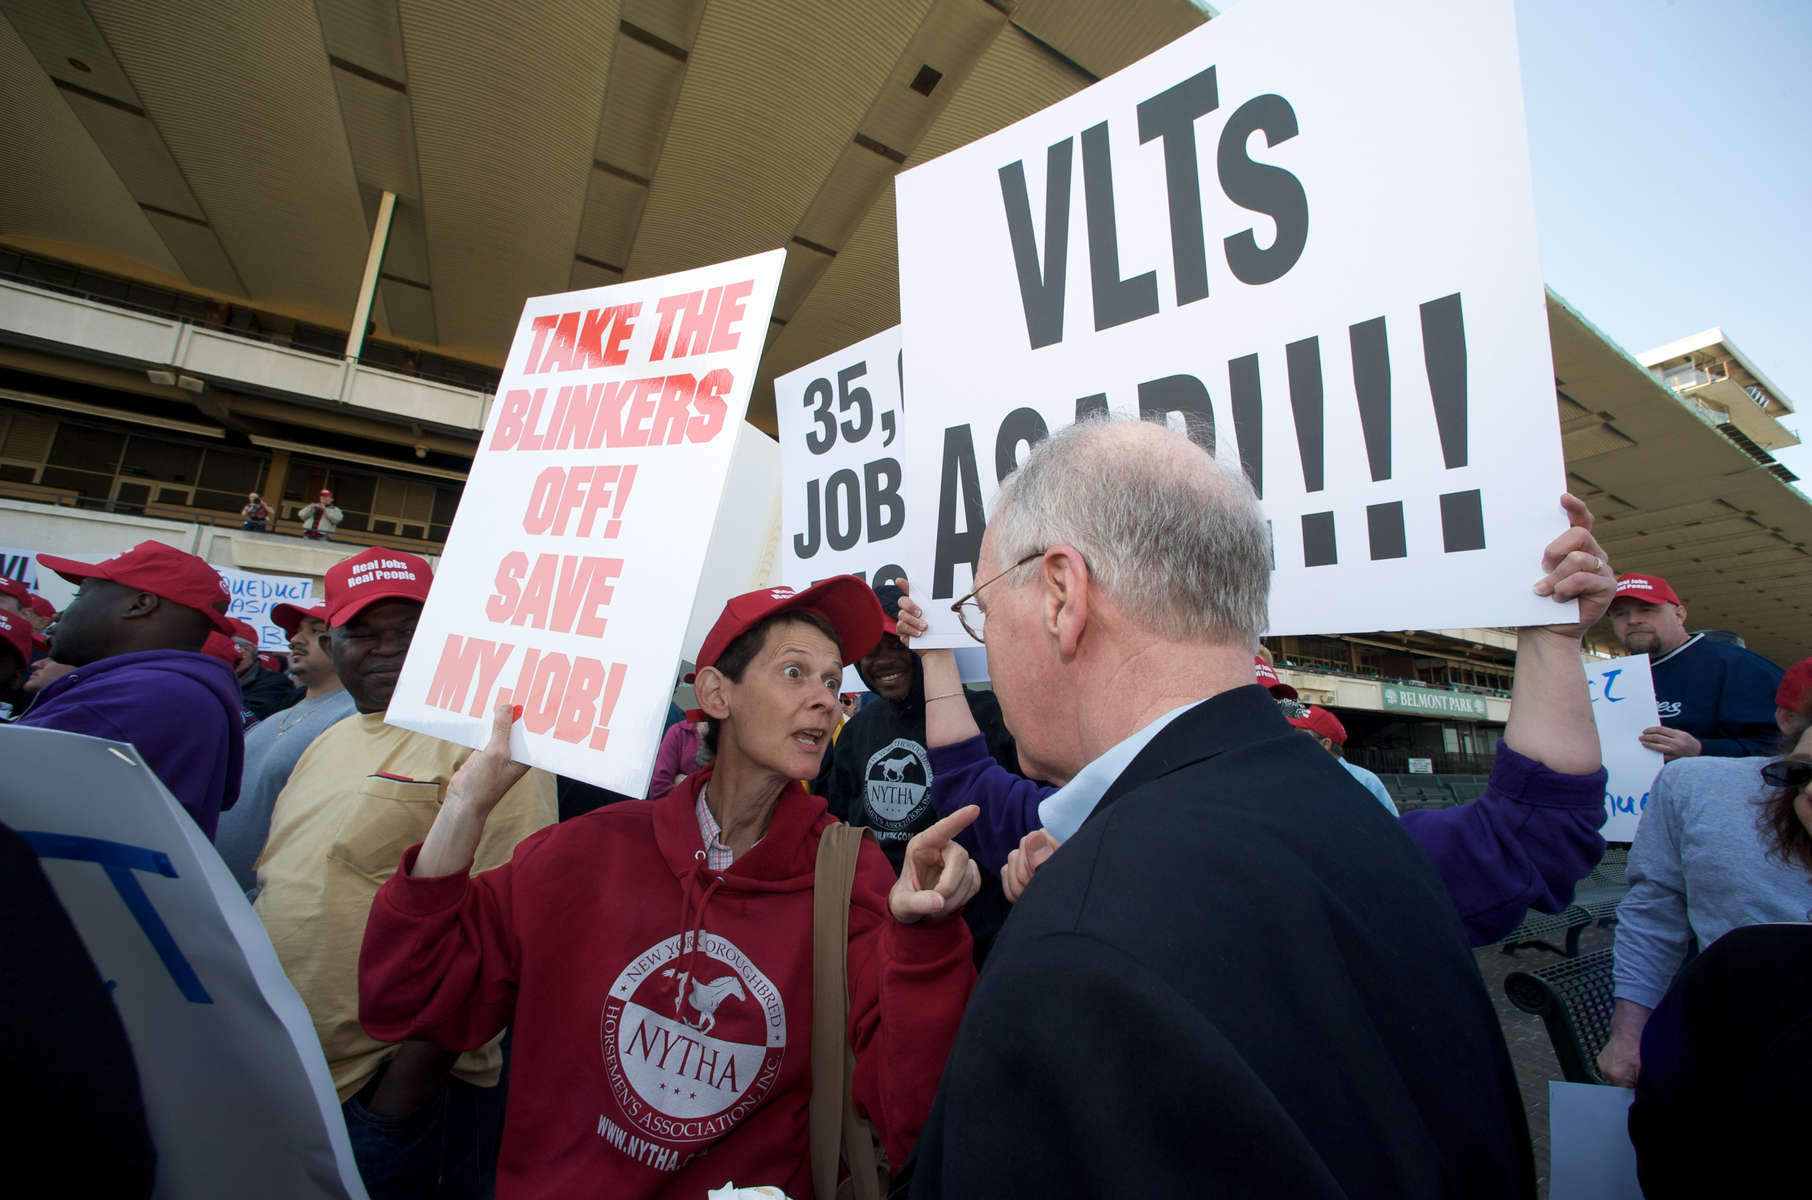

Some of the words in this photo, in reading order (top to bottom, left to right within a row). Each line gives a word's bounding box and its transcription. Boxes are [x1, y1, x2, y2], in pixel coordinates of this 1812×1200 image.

[524, 301, 640, 375] TAKE
[649, 279, 754, 362] THE
[489, 368, 734, 452] BLINKERS
[523, 464, 639, 540] OFF!
[347, 571, 375, 588] Real
[375, 570, 416, 582] People
[352, 559, 380, 575] Real
[381, 559, 408, 570] Jobs
[485, 551, 624, 638] SAVE
[425, 634, 514, 719] MY
[493, 648, 628, 752] JOB!
[1400, 690, 1447, 711] BELMONT
[1448, 696, 1474, 713] PARK
[625, 949, 662, 983] NEW
[623, 1018, 740, 1093] NYTHA
